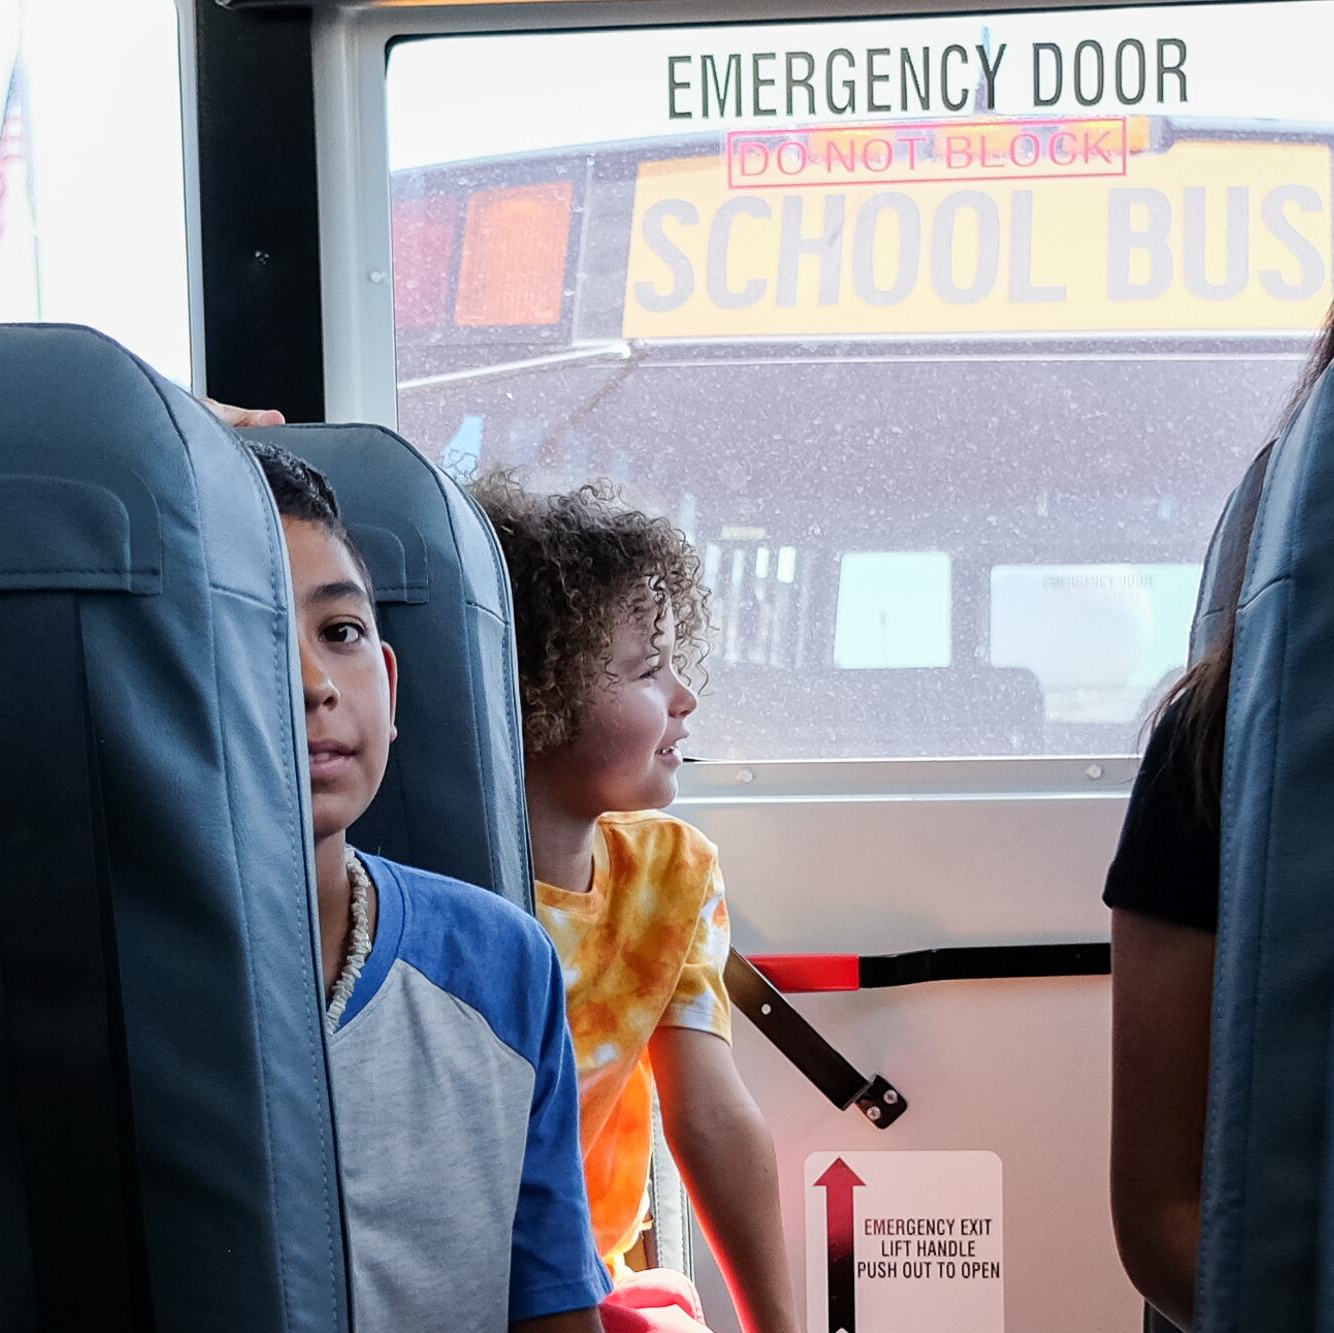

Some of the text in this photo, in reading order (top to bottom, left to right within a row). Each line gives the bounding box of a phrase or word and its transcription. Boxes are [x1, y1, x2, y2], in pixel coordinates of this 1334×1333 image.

[667, 38, 1189, 119] EMERGENCY DOOR
[737, 130, 1113, 178] DO NOT BLOCK
[633, 184, 1327, 313] SCHOOL BUS
[864, 1218, 992, 1236] EMERGENCY EXIT
[881, 1240, 976, 1257] LIFT HANDLE
[857, 1261, 1000, 1279] PUSH OUT TO OPEN
